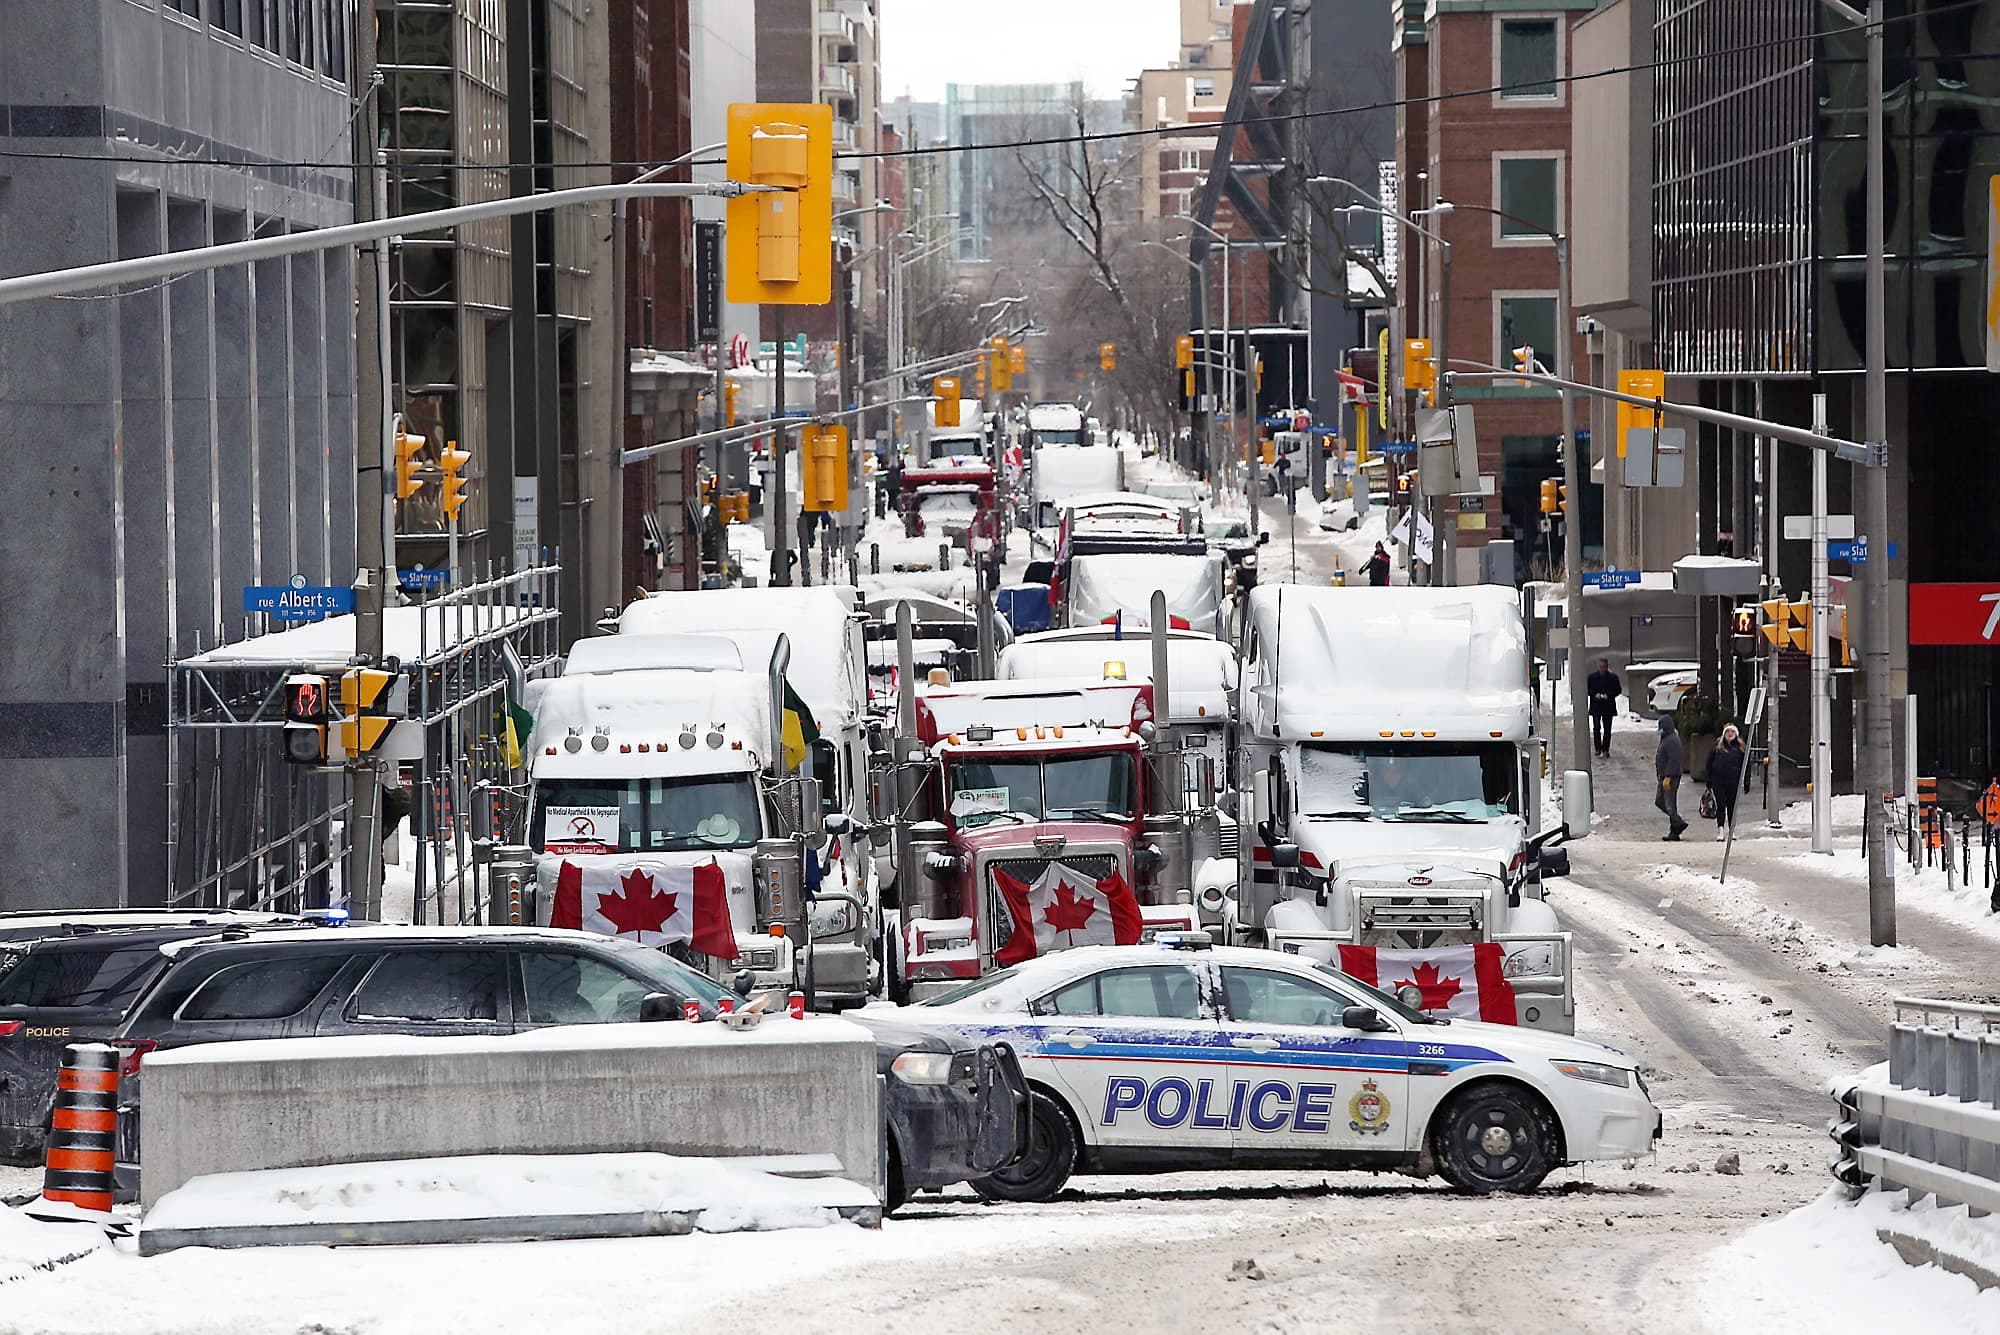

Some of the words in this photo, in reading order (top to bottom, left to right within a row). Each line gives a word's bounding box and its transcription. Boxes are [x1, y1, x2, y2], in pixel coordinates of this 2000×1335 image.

[1851, 545, 1868, 556] Slat
[409, 572, 432, 582] Slater
[1601, 574, 1623, 583] Slater
[258, 599, 275, 608] rue
[278, 590, 323, 608] Albert
[326, 596, 339, 608] St.
[553, 808, 567, 816] Medical
[568, 808, 586, 817] Apartheid
[591, 808, 596, 816] No
[597, 808, 619, 818] Segregation
[26, 1027, 71, 1037] POLICE
[1418, 1044, 1446, 1055] 3266
[1100, 1075, 1337, 1134] POLICE
